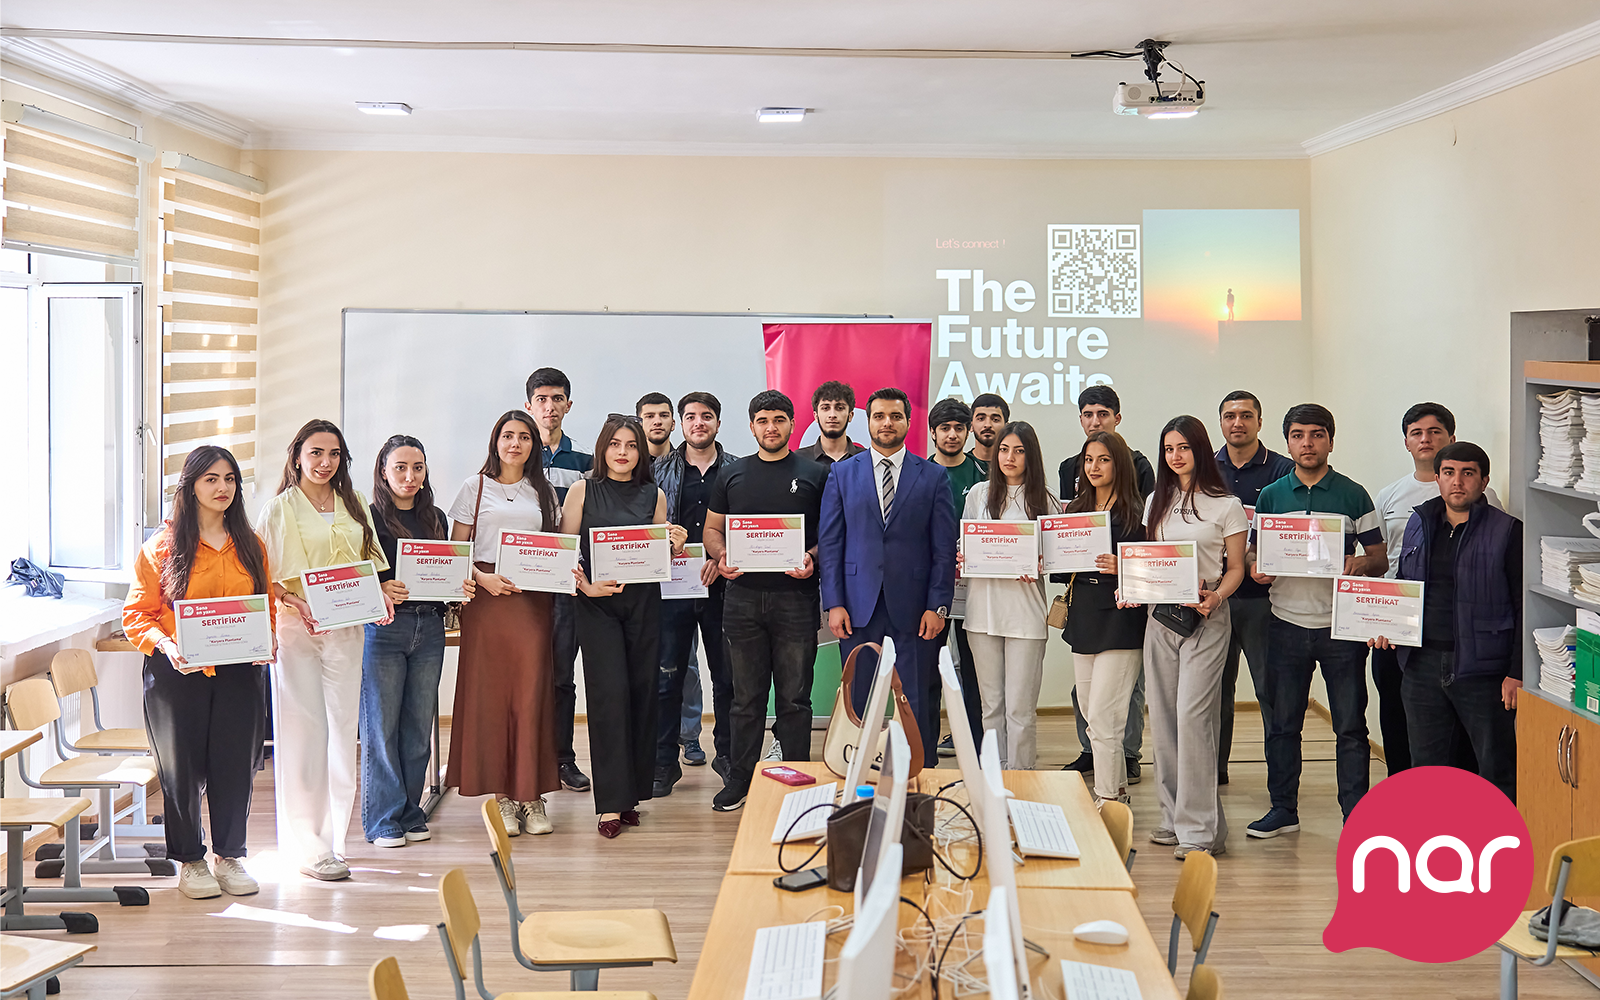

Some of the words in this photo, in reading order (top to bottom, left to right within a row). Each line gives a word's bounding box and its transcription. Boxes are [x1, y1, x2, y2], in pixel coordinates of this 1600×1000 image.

[936, 238, 960, 249] Let's
[962, 239, 999, 249] connect
[936, 269, 1036, 313] The
[938, 315, 1109, 360] Future
